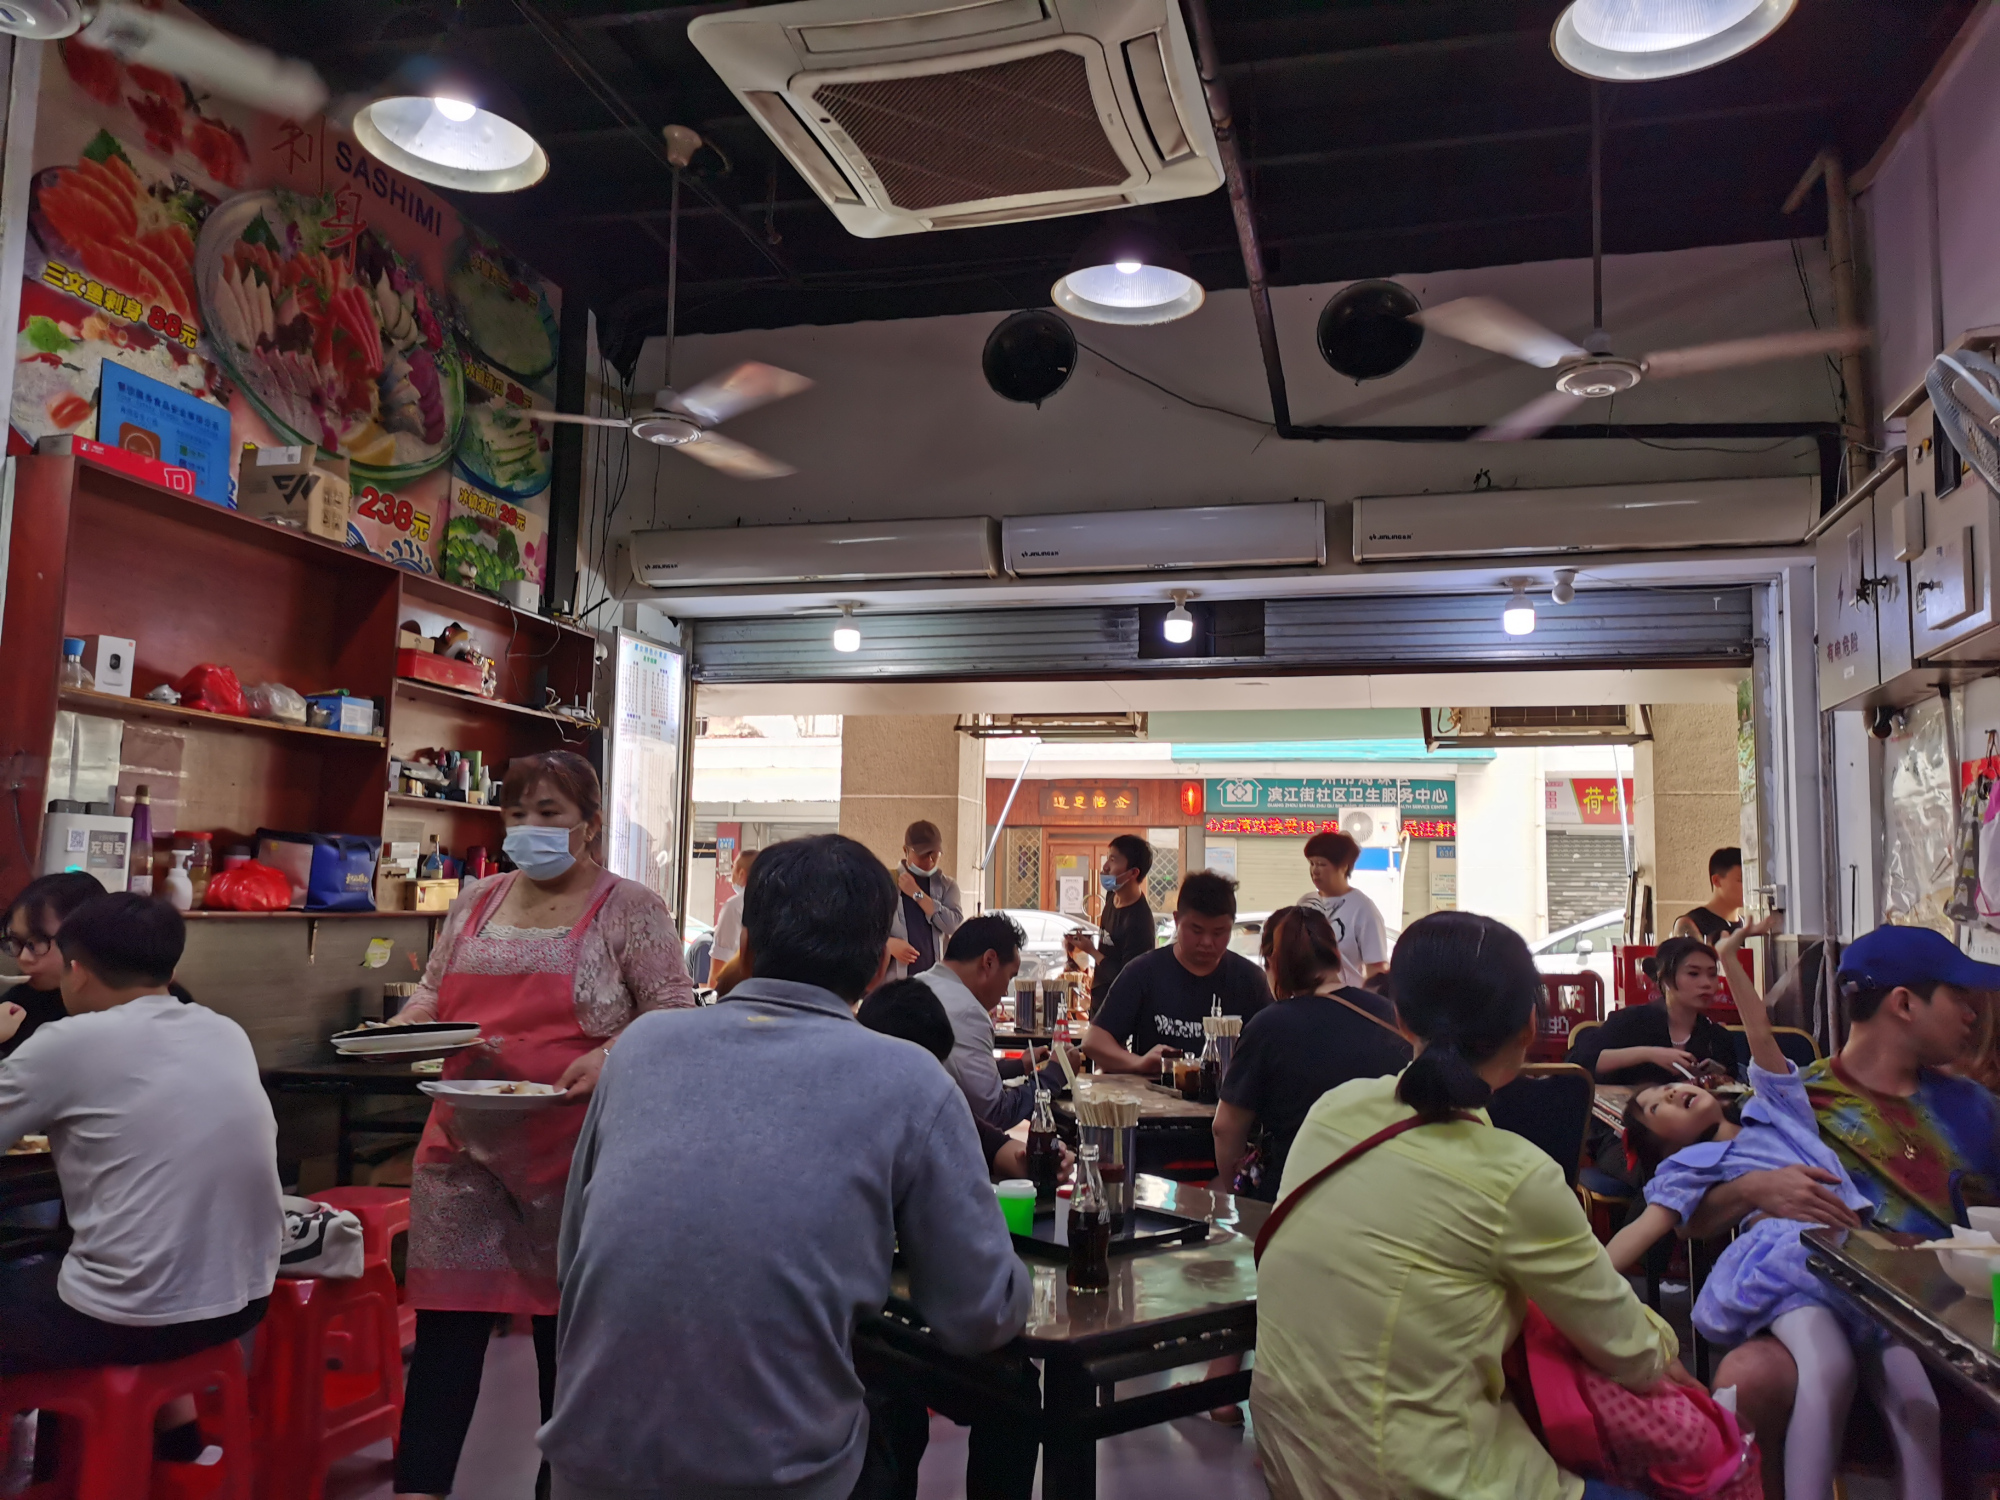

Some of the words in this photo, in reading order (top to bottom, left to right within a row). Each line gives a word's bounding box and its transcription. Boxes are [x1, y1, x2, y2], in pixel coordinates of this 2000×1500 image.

[335, 140, 442, 237] SASHIMI
[147, 305, 198, 349] 88元
[499, 504, 527, 532] 28元
[1826, 630, 1859, 664] 有电危险
[1267, 786, 1449, 804] 滨江街社区卫生服务中心
[90, 841, 126, 856] 充电宝
